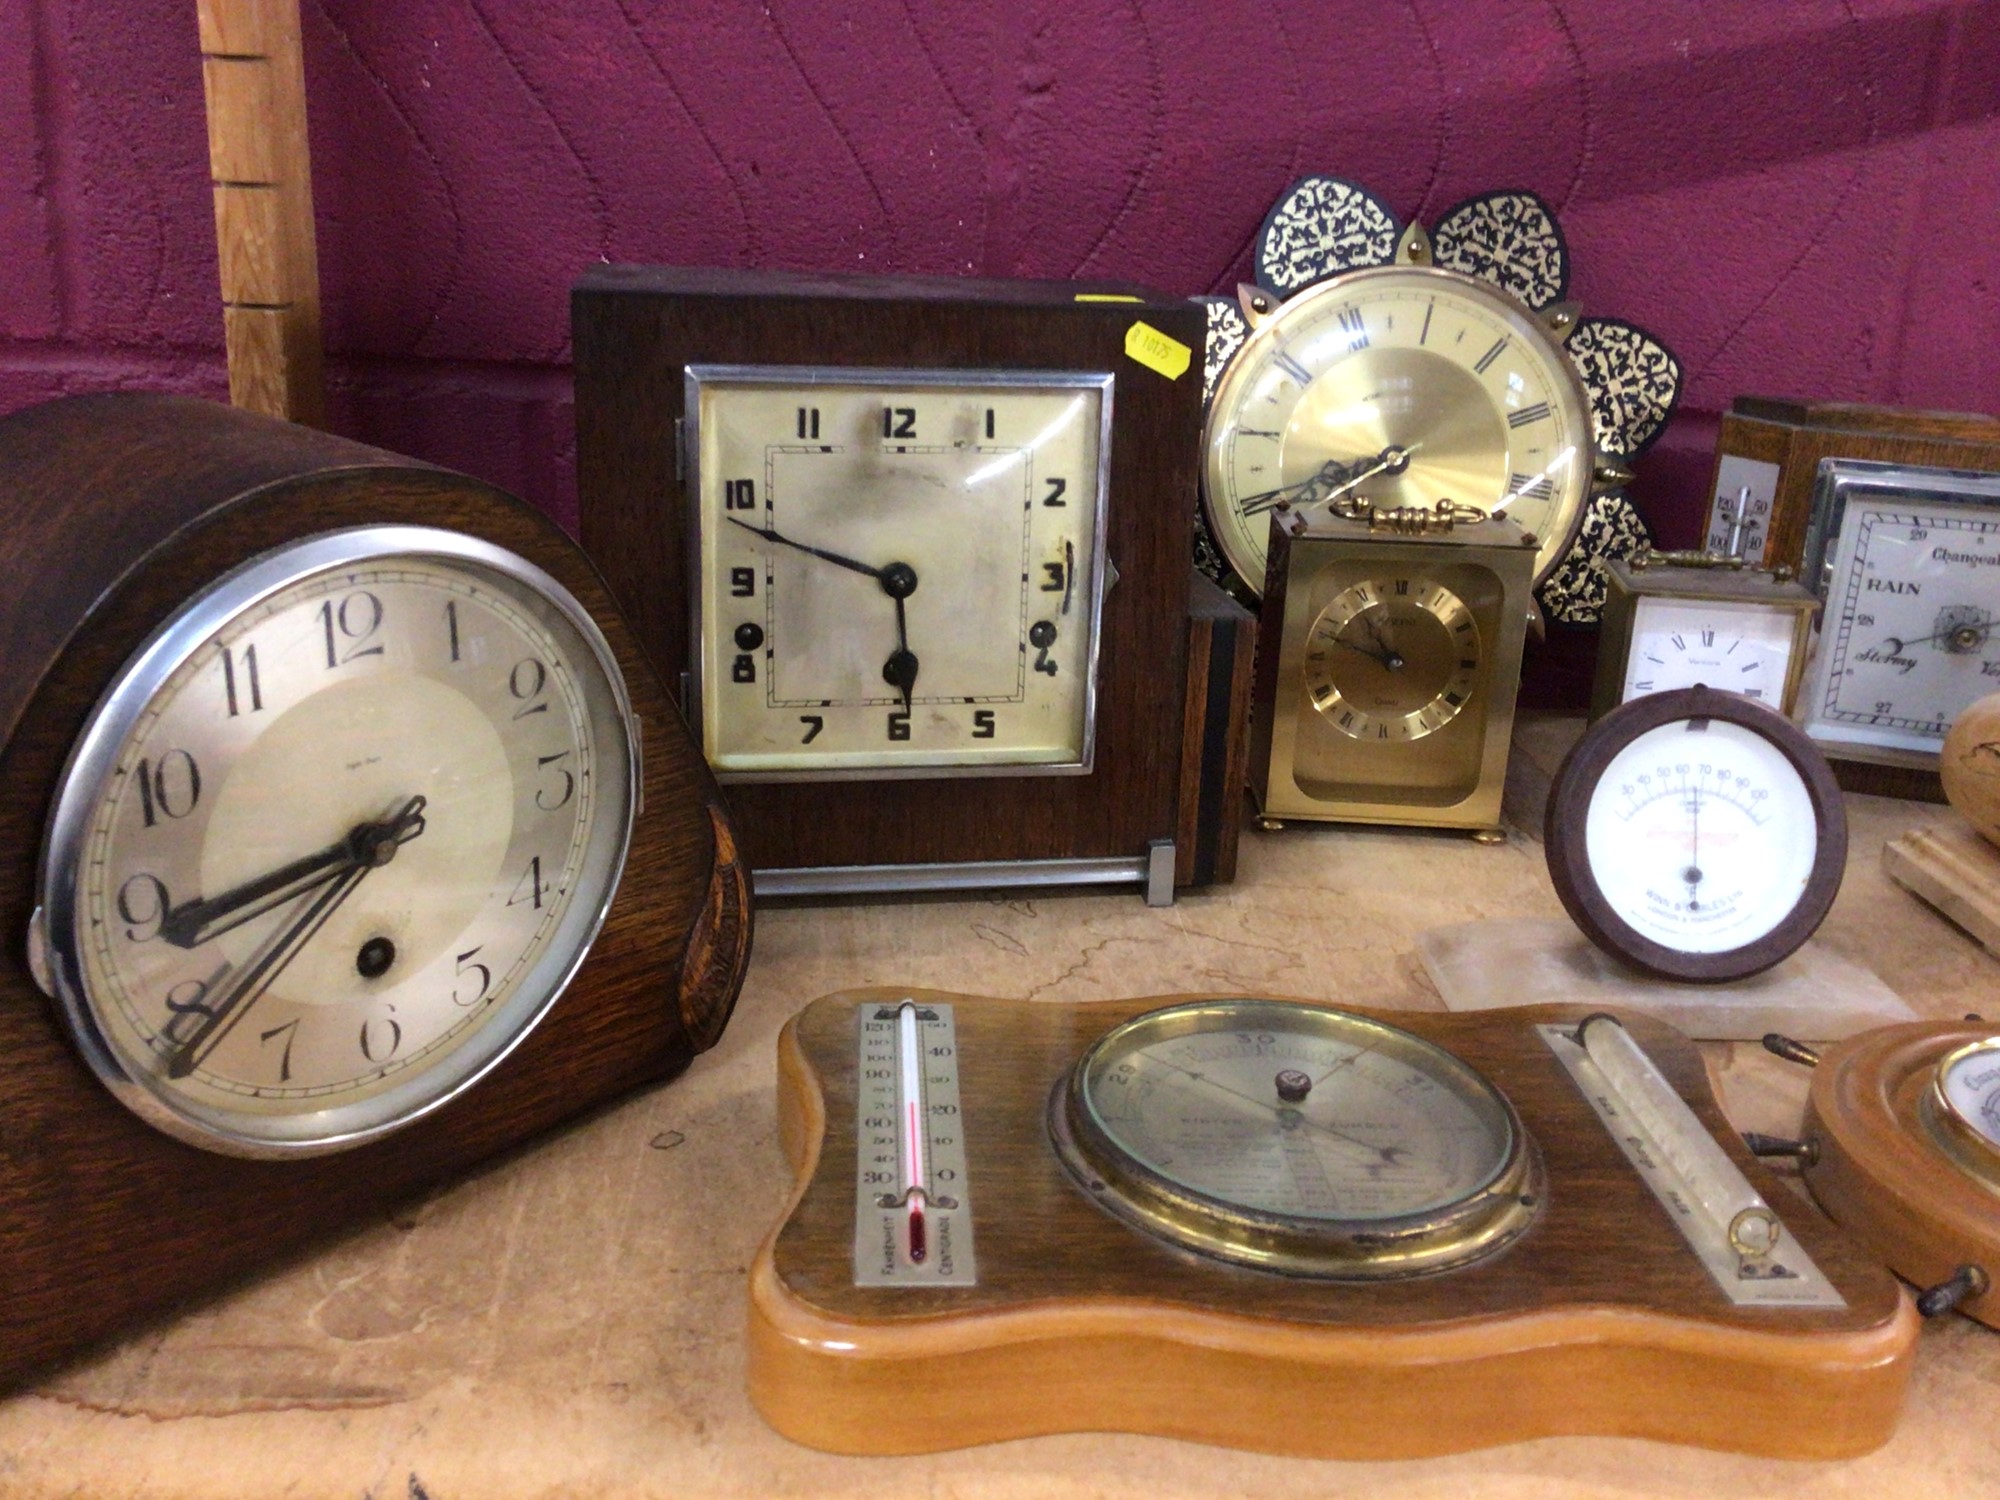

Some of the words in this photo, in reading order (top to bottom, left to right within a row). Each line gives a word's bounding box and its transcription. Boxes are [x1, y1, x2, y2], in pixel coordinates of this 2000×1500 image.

[798, 408, 819, 439] 11
[884, 408, 916, 438] 12
[986, 409, 995, 438] 1
[726, 479, 755, 509] 10
[1044, 479, 1066, 507] 2
[732, 568, 755, 597] 9
[1041, 563, 1064, 591] 3
[1866, 578, 1921, 596] RAIN
[315, 591, 385, 668] 12
[442, 601, 459, 662] 1
[733, 655, 755, 684] 8
[1035, 648, 1058, 676] 4
[1855, 649, 1918, 674] Stormy
[221, 643, 264, 716] 11
[509, 657, 548, 721] 2
[800, 716, 823, 744] 7
[888, 714, 911, 740] 6
[972, 711, 995, 738] 5
[535, 752, 574, 811] 3
[1657, 766, 1671, 777] 50
[1675, 763, 1690, 775] 60
[1700, 764, 1713, 775] 70
[1717, 769, 1732, 780] 80
[1735, 777, 1750, 788] 90
[134, 748, 200, 828] 10
[1750, 789, 1769, 800] 100
[506, 856, 549, 910] 4
[118, 873, 172, 942] 9
[453, 945, 490, 1007] 5
[165, 979, 213, 1047] 8
[865, 1021, 892, 1032] 120
[360, 1006, 401, 1063] 6
[1235, 1033, 1276, 1045] 30
[261, 1018, 301, 1082] 7
[867, 1054, 893, 1062] 100
[930, 1046, 952, 1057] 40
[865, 1069, 891, 1080] 90
[864, 1117, 893, 1129] 60
[931, 1104, 957, 1115] 20
[873, 1154, 894, 1164] 40
[863, 1172, 894, 1184] 30
[937, 1168, 956, 1181] 0
